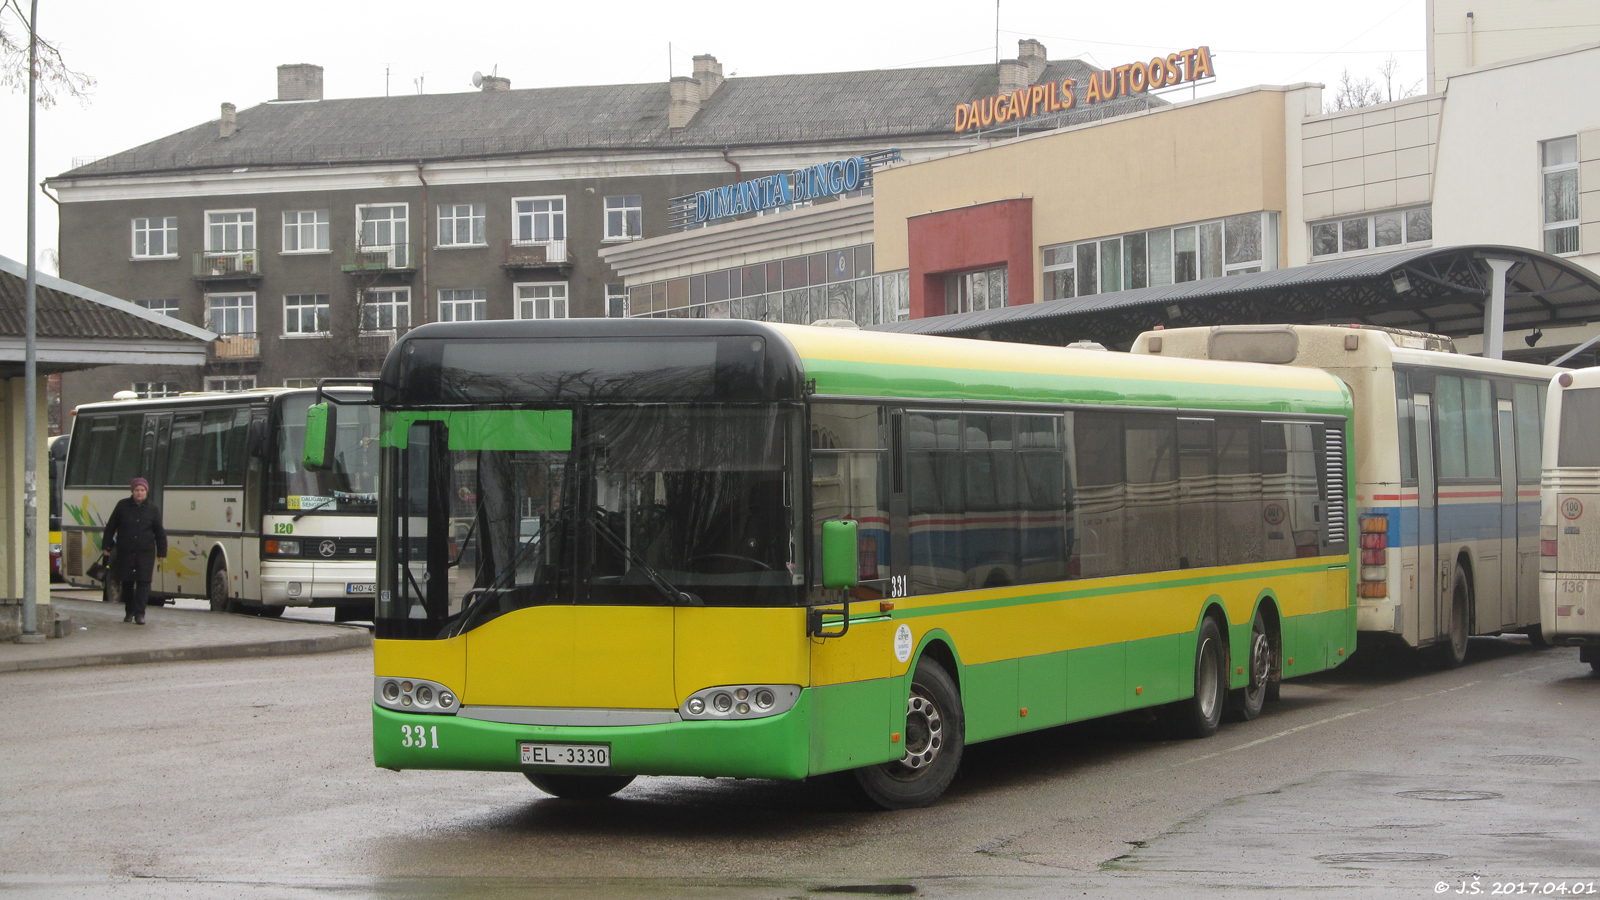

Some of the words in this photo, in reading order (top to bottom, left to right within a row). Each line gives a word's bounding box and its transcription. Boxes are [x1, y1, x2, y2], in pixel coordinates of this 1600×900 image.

[954, 78, 1076, 133] DAUGAVPILS
[1085, 46, 1213, 104] AUTOOSTA
[695, 173, 787, 222] DIMANTA
[792, 156, 863, 203] BINGO
[1565, 502, 1578, 511] 100
[274, 523, 293, 534] 120
[891, 575, 907, 598] 331
[1562, 580, 1584, 593] 136
[401, 724, 439, 749] 331
[532, 746, 607, 764] EL-3330
